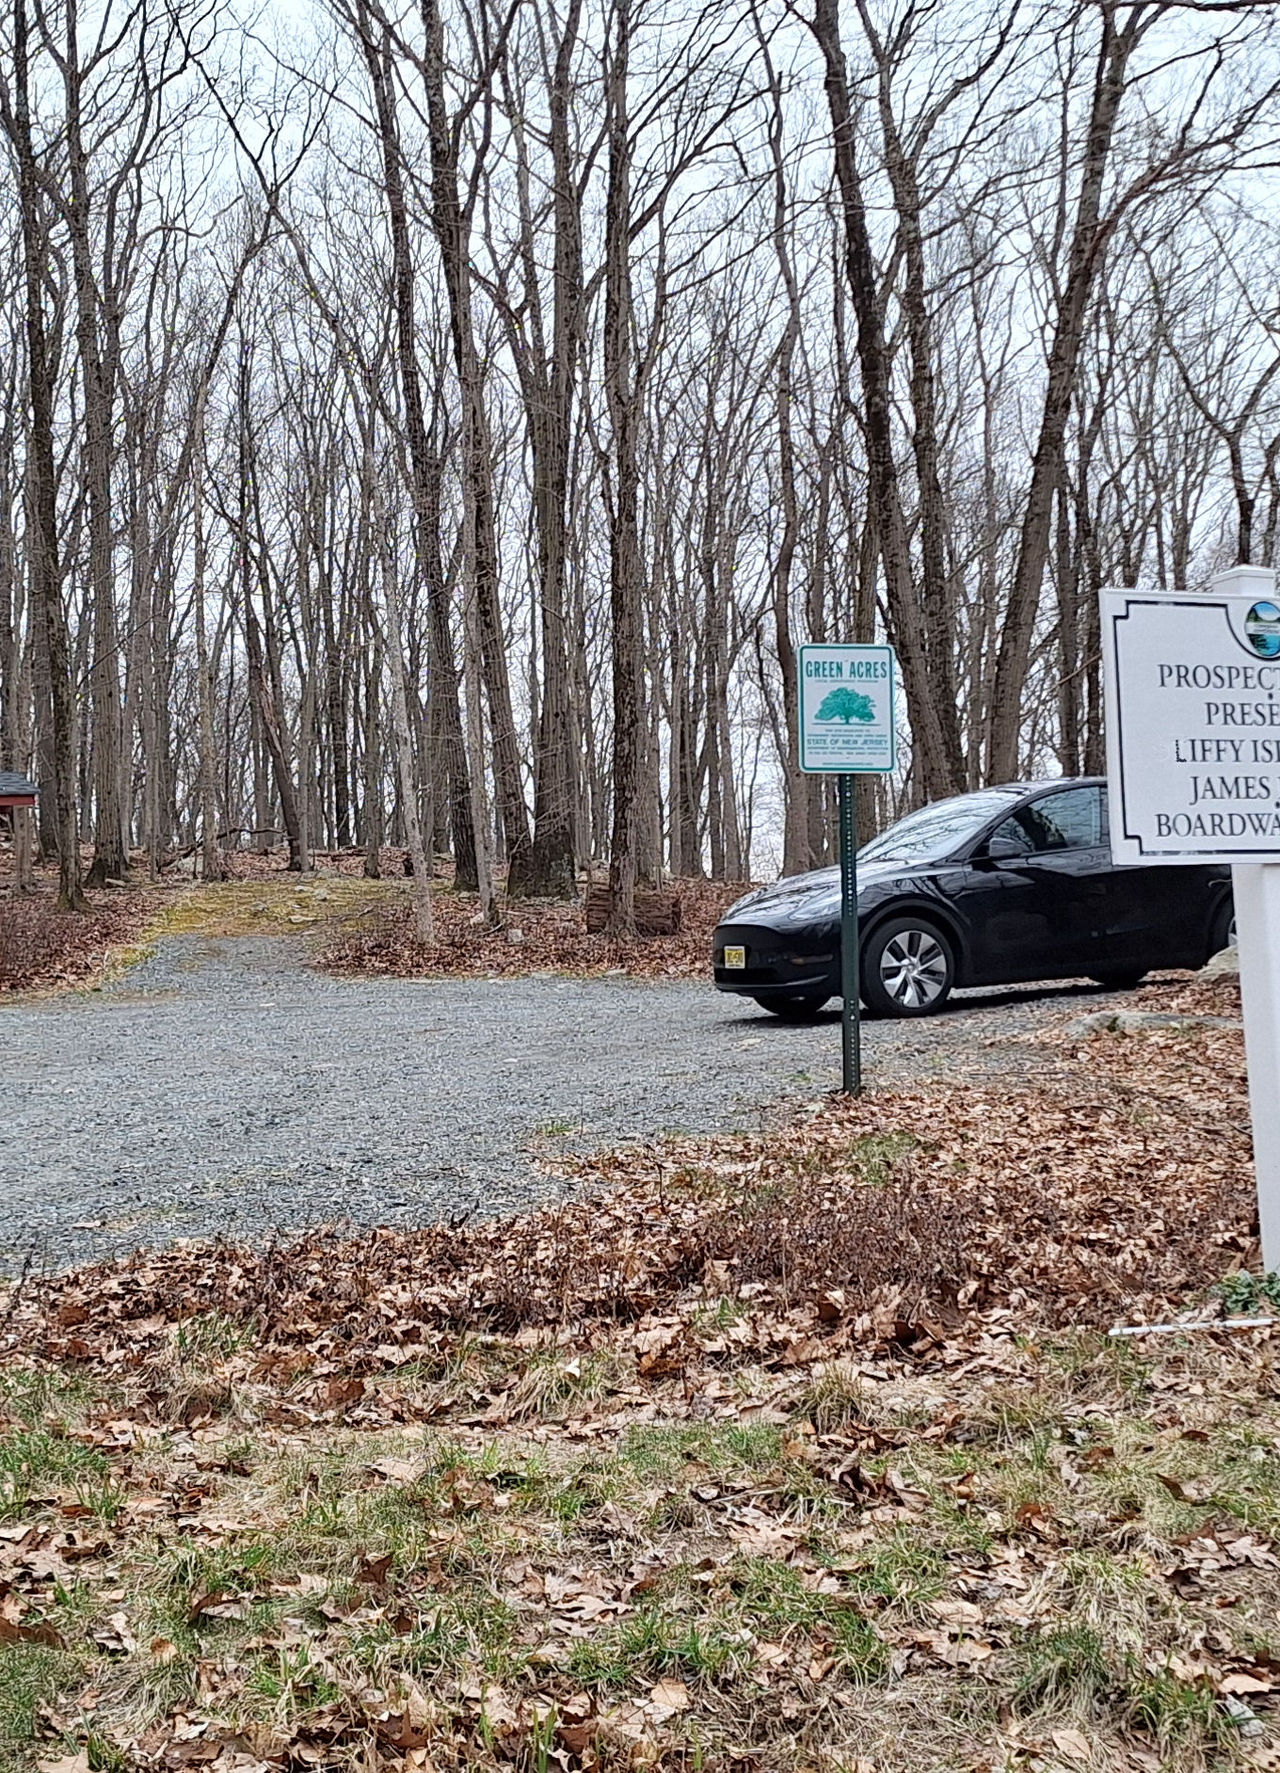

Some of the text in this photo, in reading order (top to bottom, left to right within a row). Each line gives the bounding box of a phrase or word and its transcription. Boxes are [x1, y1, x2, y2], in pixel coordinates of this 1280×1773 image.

[805, 660, 887, 679] GREEN ACRES
[1175, 738, 1244, 765] LIFFY
[1189, 776, 1271, 805] JAMES
